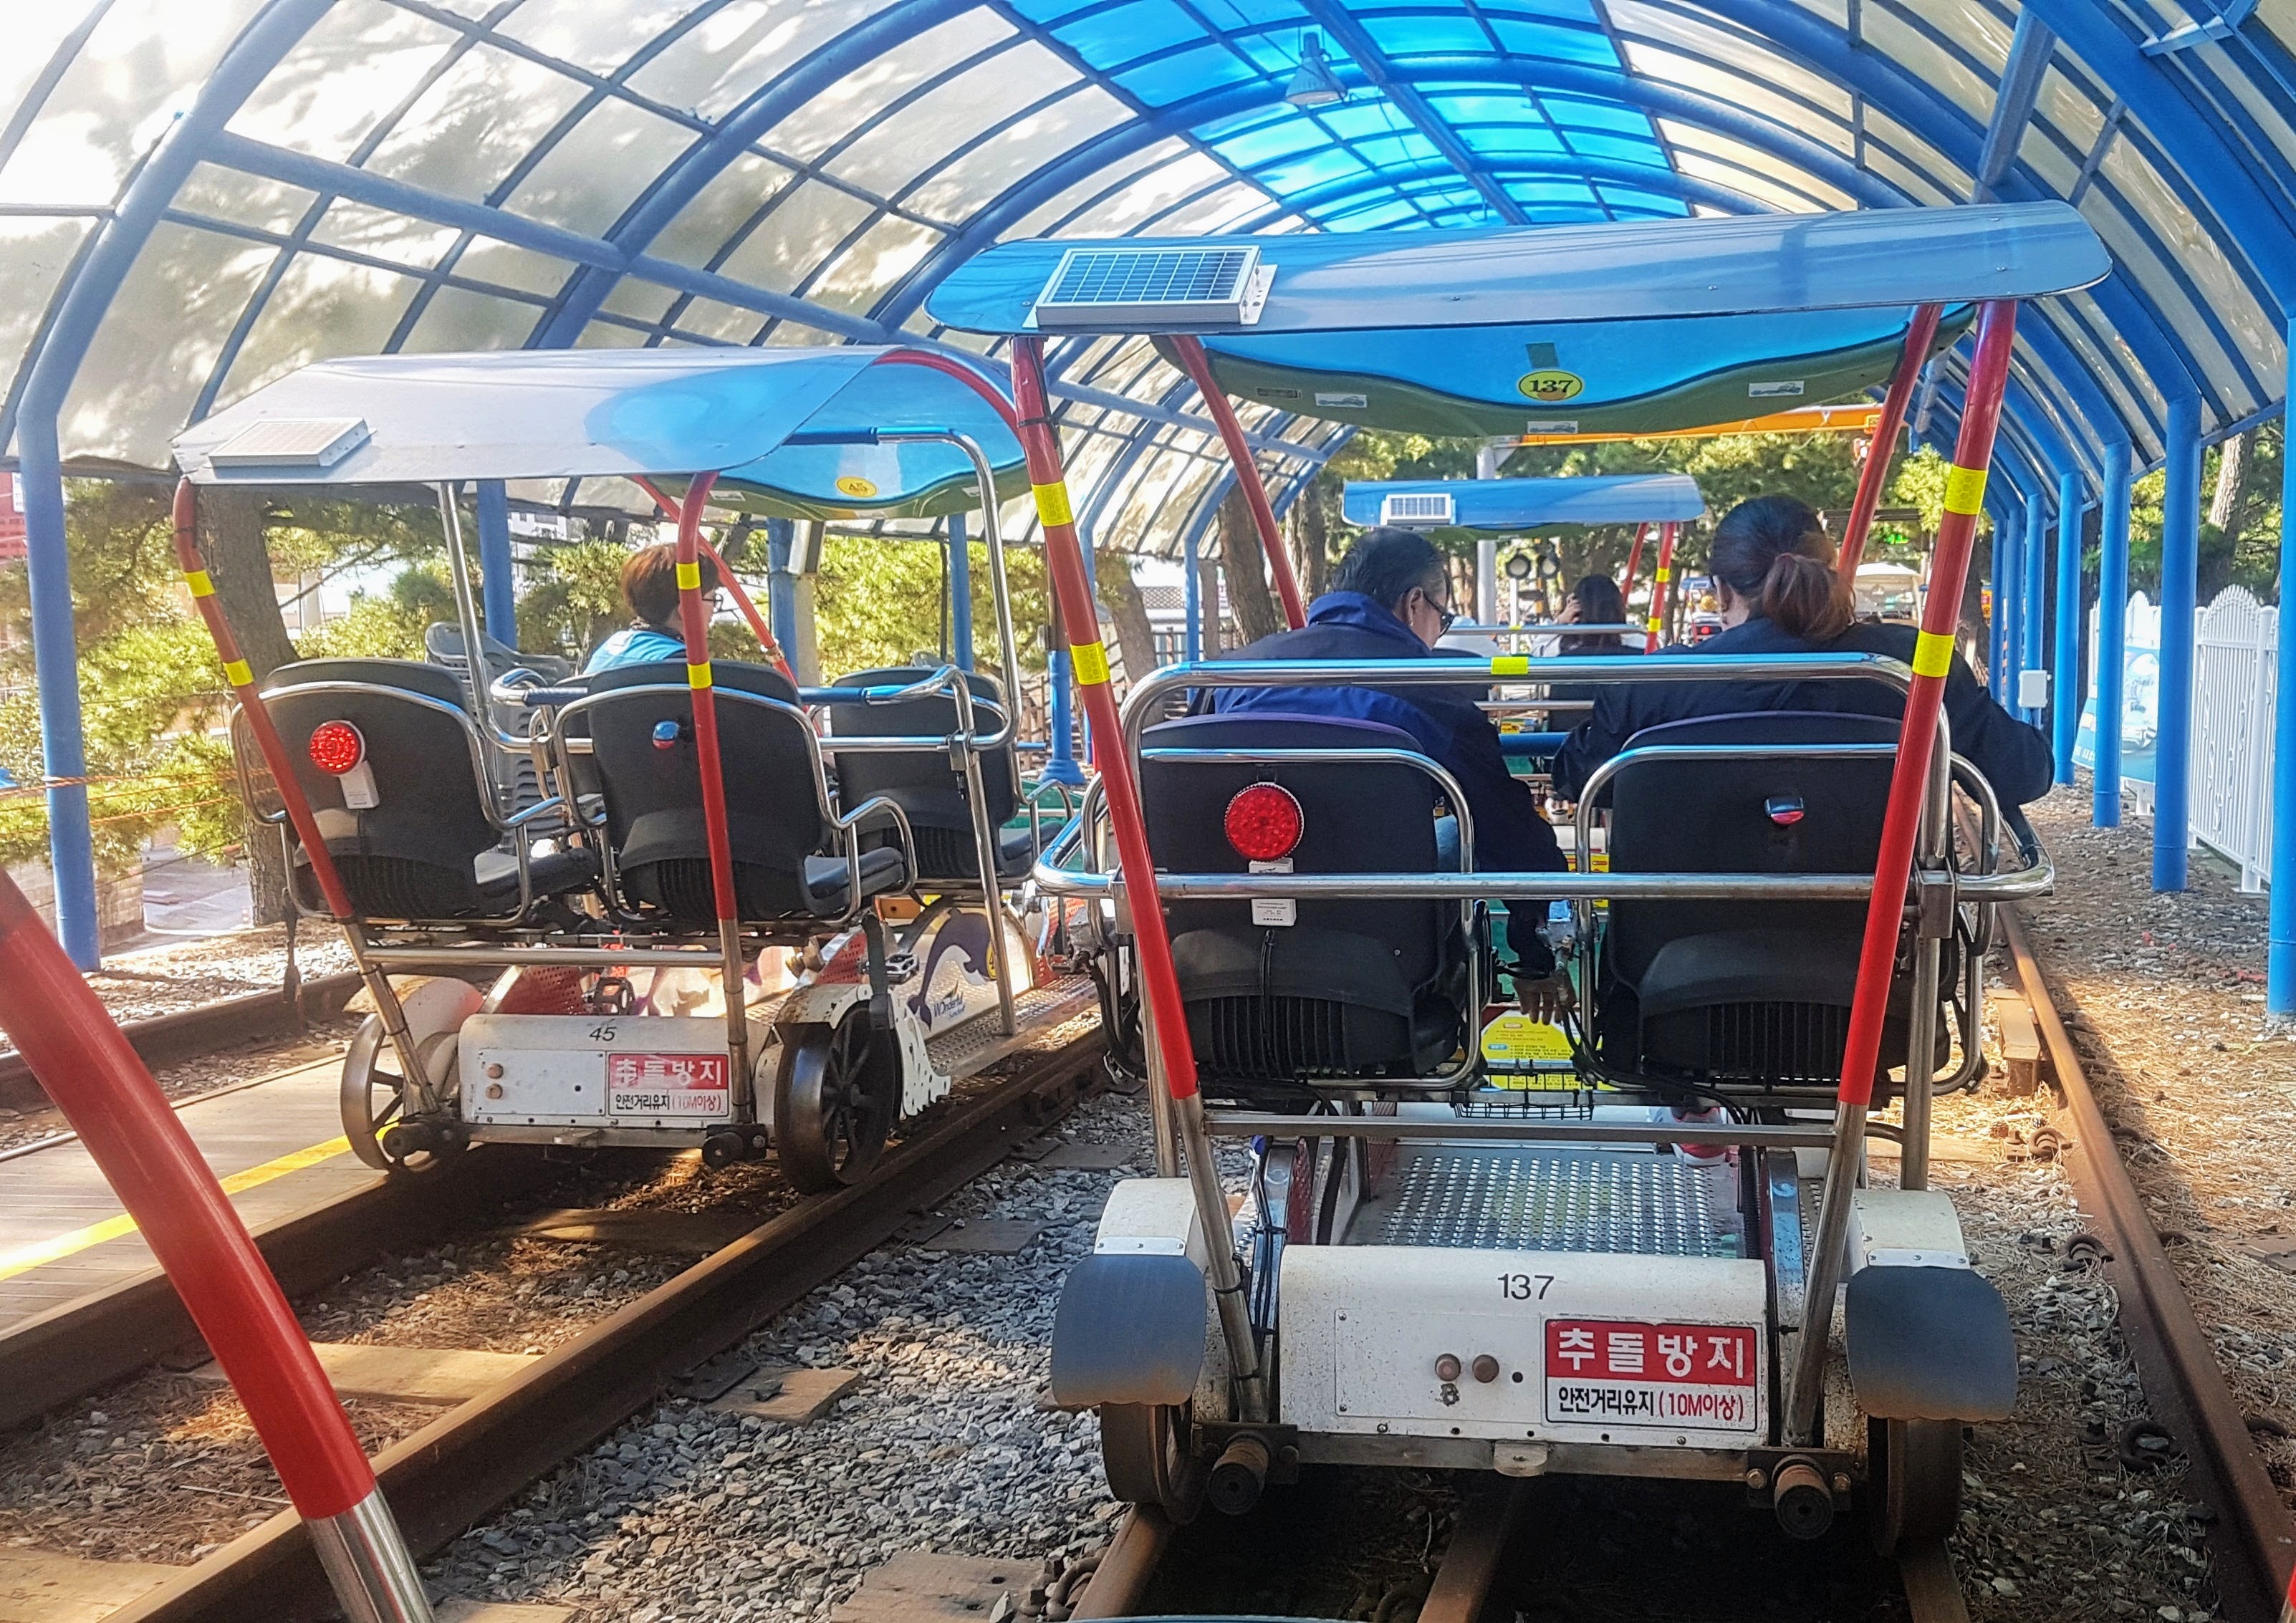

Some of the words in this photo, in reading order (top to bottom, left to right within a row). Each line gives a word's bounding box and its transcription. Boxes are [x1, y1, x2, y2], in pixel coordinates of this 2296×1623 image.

[1529, 379, 1574, 393] 137
[589, 1026, 617, 1041] 45
[615, 1093, 670, 1111] 안전거리유지
[1497, 1273, 1555, 1300] 137
[1557, 1327, 1744, 1379] 추돌방지
[1558, 1386, 1654, 1417] 안전거리유지
